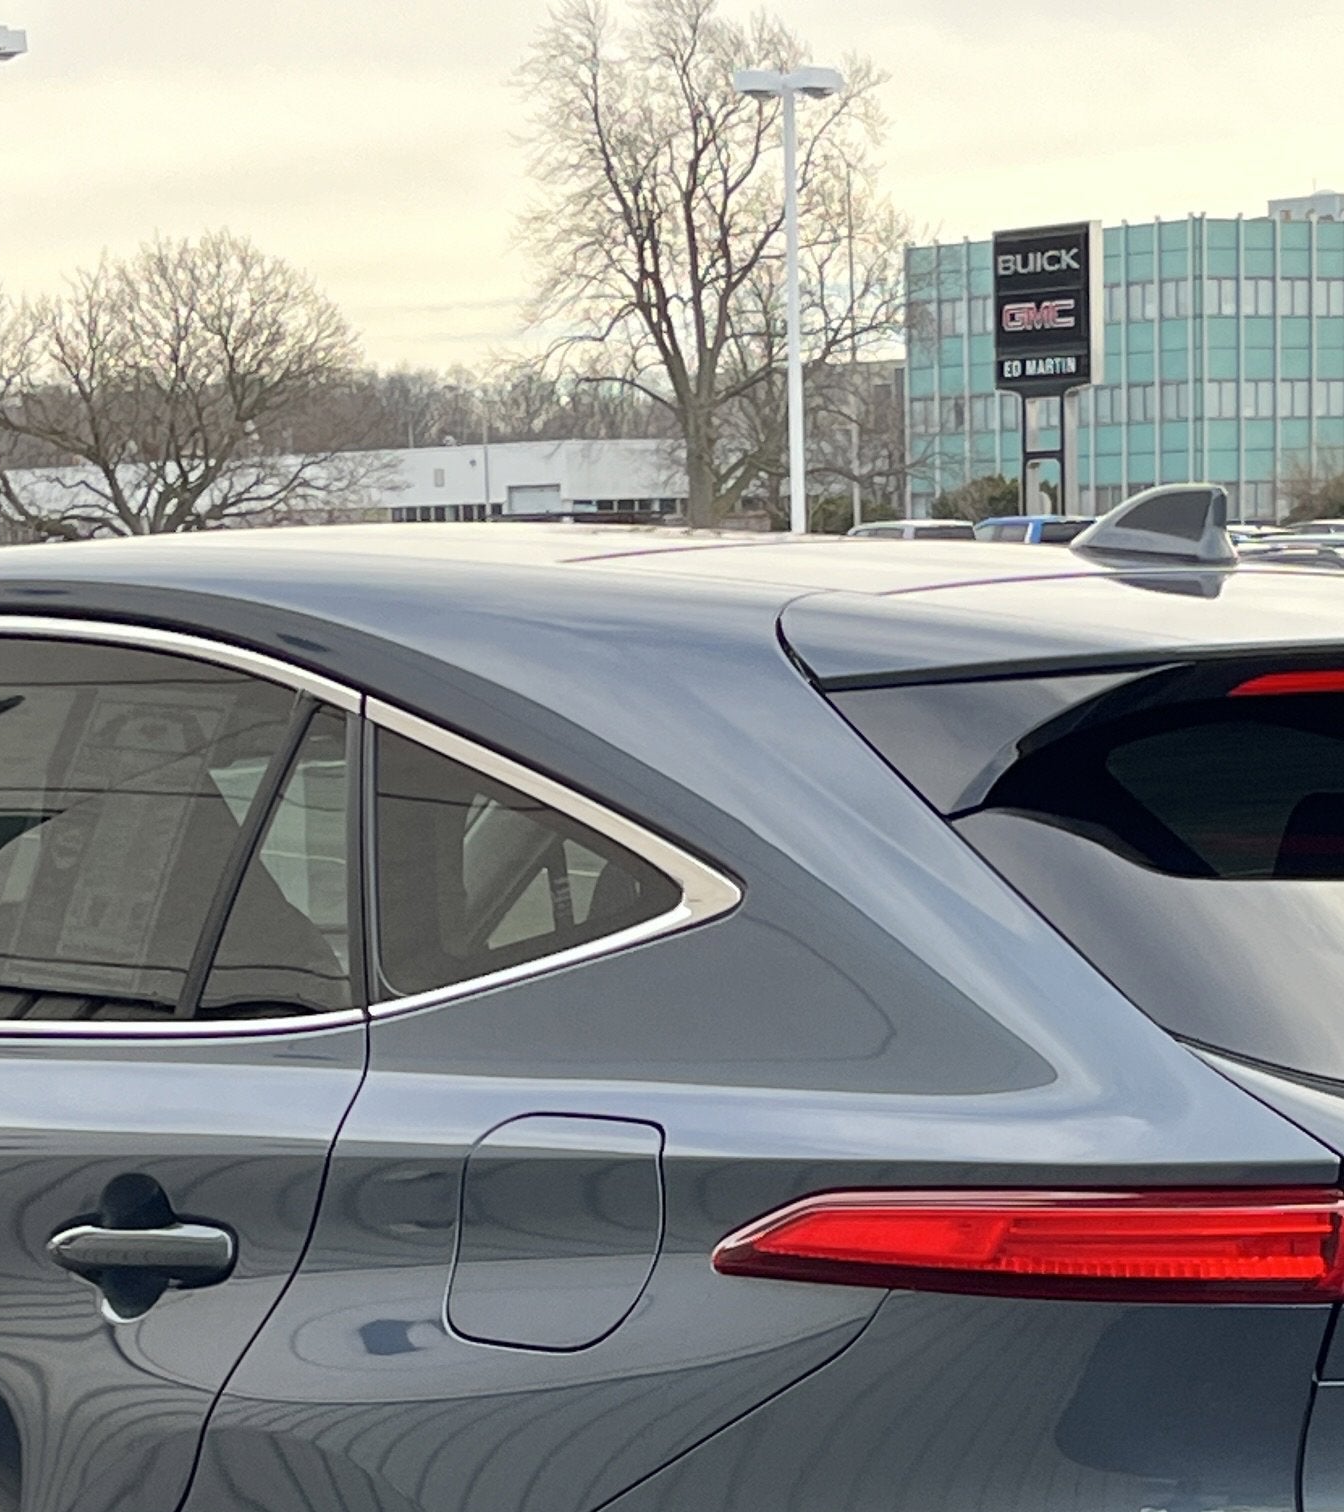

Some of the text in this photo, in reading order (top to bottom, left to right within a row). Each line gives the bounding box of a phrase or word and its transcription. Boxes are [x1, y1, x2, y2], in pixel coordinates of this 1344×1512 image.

[997, 247, 1080, 276] BUICK
[1002, 299, 1076, 332] GMC
[1003, 356, 1077, 378] ED MARTIN
